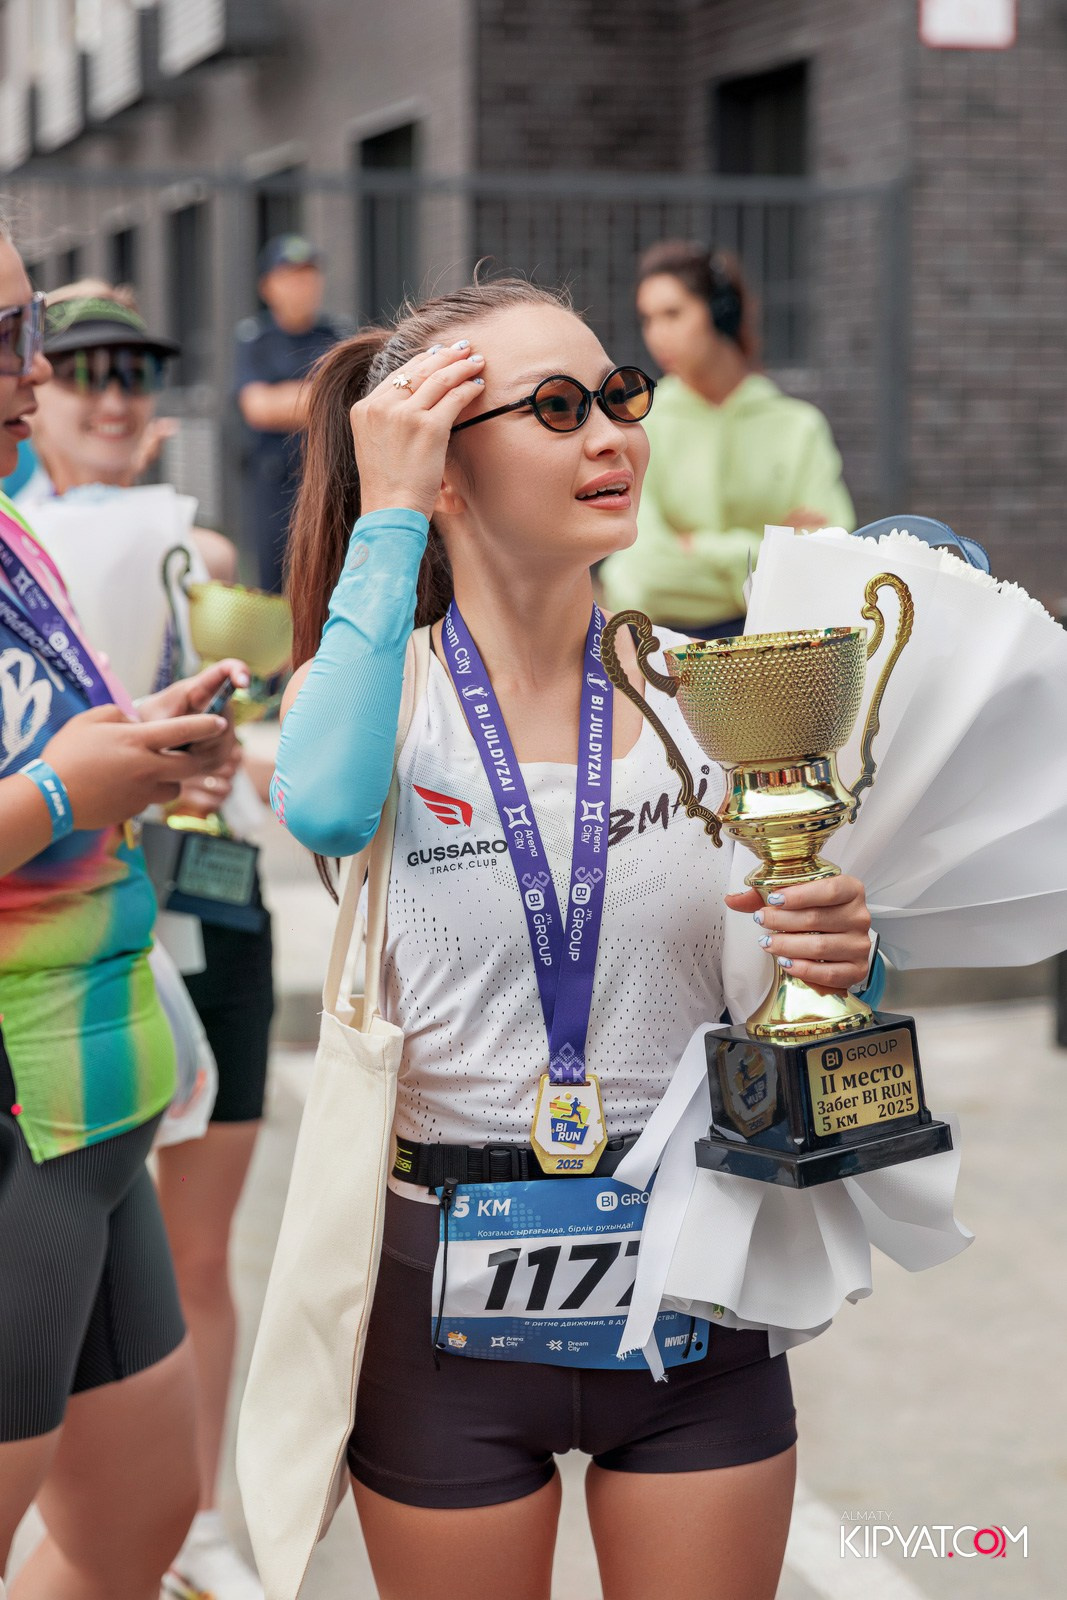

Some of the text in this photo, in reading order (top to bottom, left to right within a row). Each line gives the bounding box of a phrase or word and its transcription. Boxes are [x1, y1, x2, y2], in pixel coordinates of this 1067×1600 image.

[454, 647, 472, 674] City
[474, 703, 516, 792] BI JULDYZAI
[587, 694, 604, 787] BI JULDYZAI
[514, 830, 525, 850] City
[524, 829, 538, 857] Arena
[581, 825, 592, 844] City
[593, 825, 603, 853] Arena
[430, 858, 497, 875] TRACK CLUB
[533, 913, 552, 966] GROUP
[568, 908, 585, 961] GROUP
[846, 1039, 898, 1062] GROUP
[842, 1063, 904, 1091] место
[817, 1080, 912, 1115] Забег BI RUN
[822, 1097, 914, 1131] 5 км 2025
[556, 1123, 567, 1133] BI
[558, 1132, 581, 1141] RUN
[556, 1159, 584, 1170] 2025
[453, 1195, 470, 1218] 5
[620, 1192, 650, 1206] GRO
[664, 1332, 698, 1348] INVICTS
